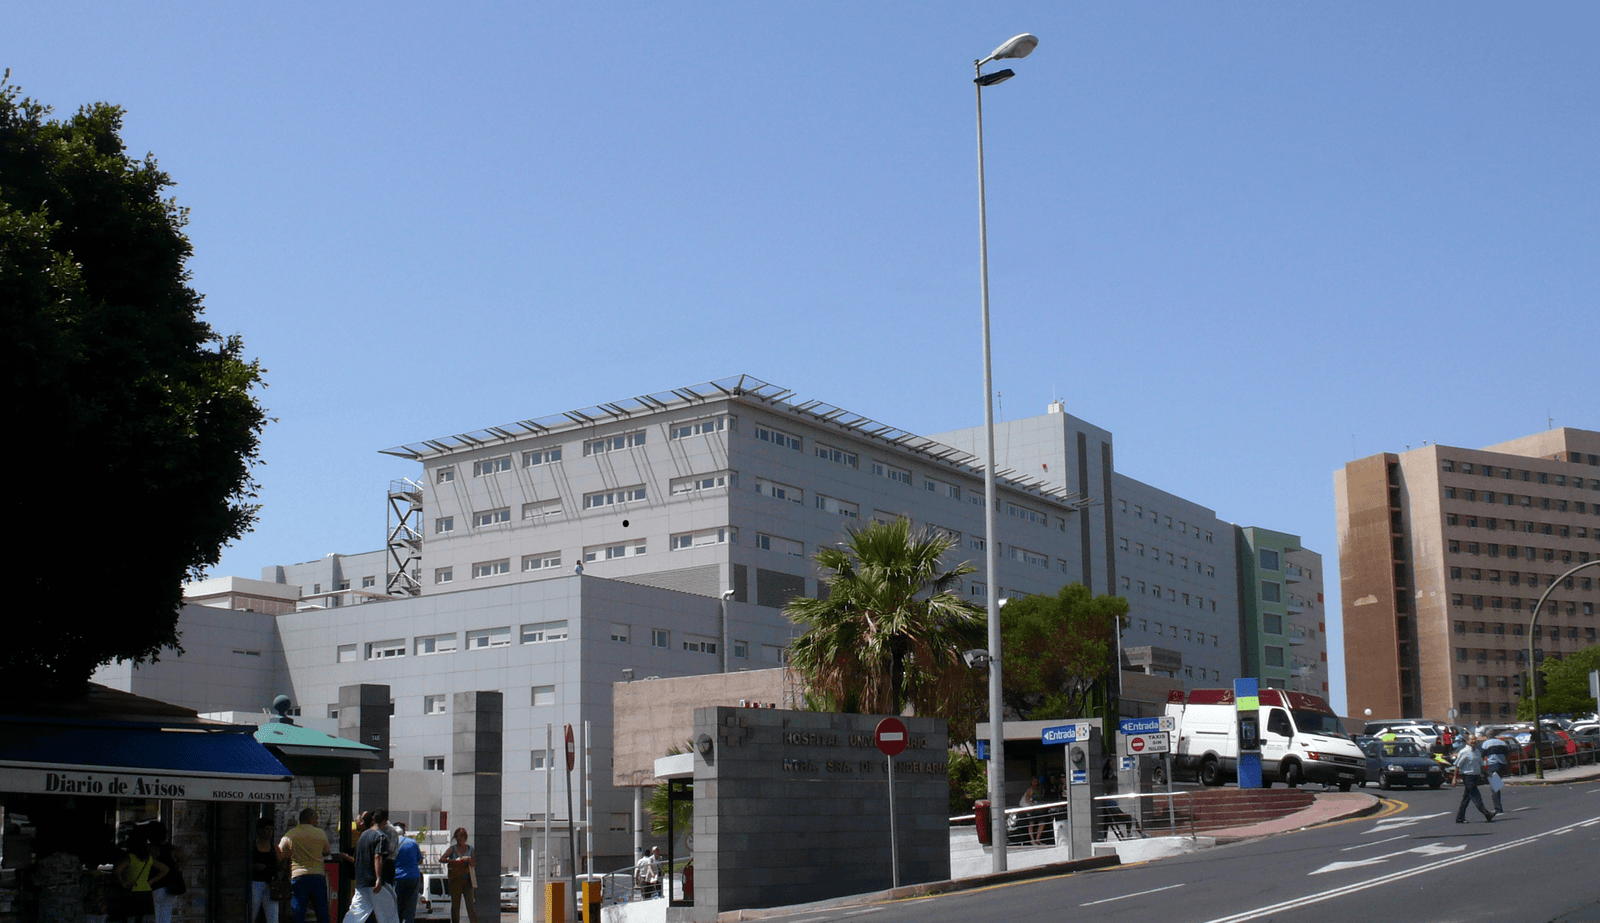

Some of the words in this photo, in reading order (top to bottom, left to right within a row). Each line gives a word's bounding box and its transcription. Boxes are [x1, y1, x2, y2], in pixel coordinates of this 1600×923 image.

[1127, 721, 1159, 731] Entrada
[783, 732, 839, 747] HOSPITAL
[1049, 729, 1076, 741] Entrada
[45, 773, 103, 794] Diario
[108, 776, 129, 795] de
[133, 777, 186, 797] Avisos
[212, 790, 244, 799] KIOSCO
[248, 792, 285, 800] AGUSTIN
